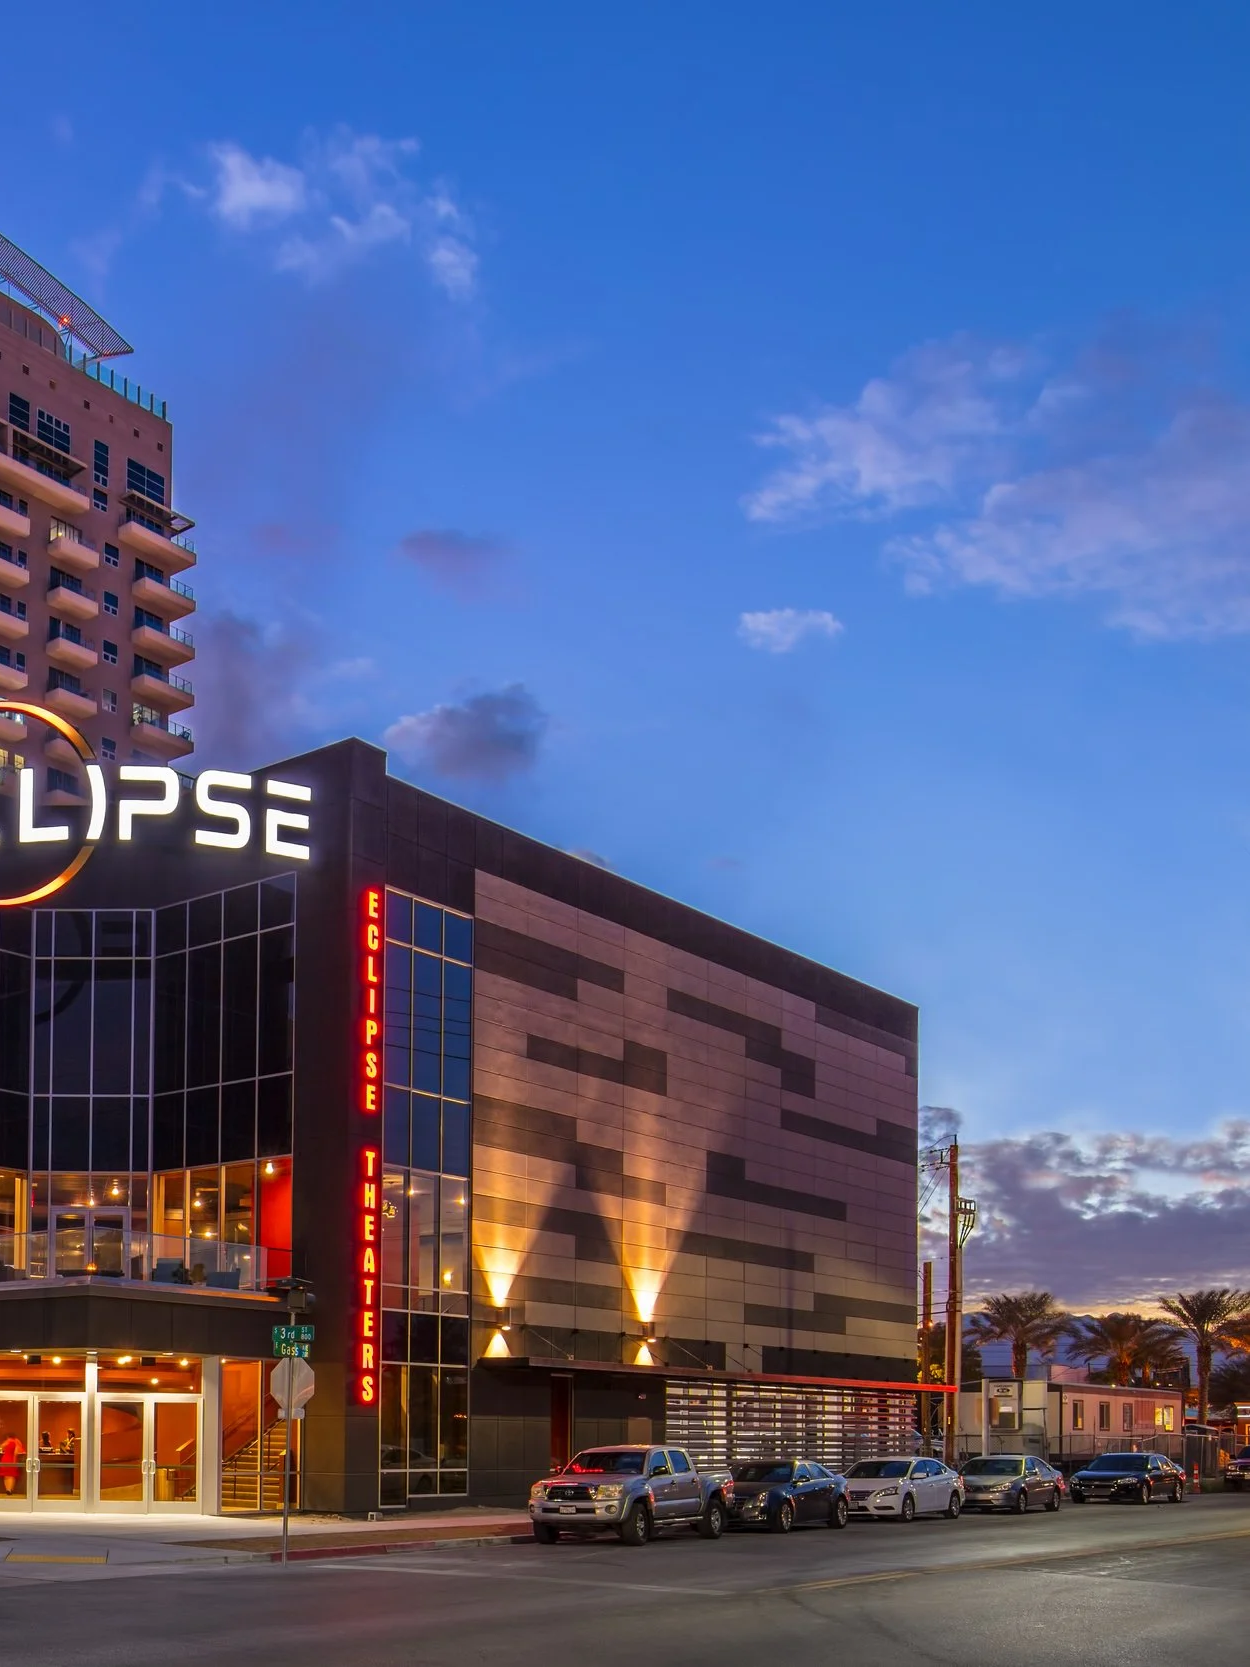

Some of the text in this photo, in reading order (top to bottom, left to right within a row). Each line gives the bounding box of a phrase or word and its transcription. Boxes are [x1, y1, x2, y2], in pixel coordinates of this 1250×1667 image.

[361, 891, 380, 1402] ECLIPSE THEATERS
[280, 1327, 295, 1339] 3rd
[281, 1343, 299, 1356] Gass
